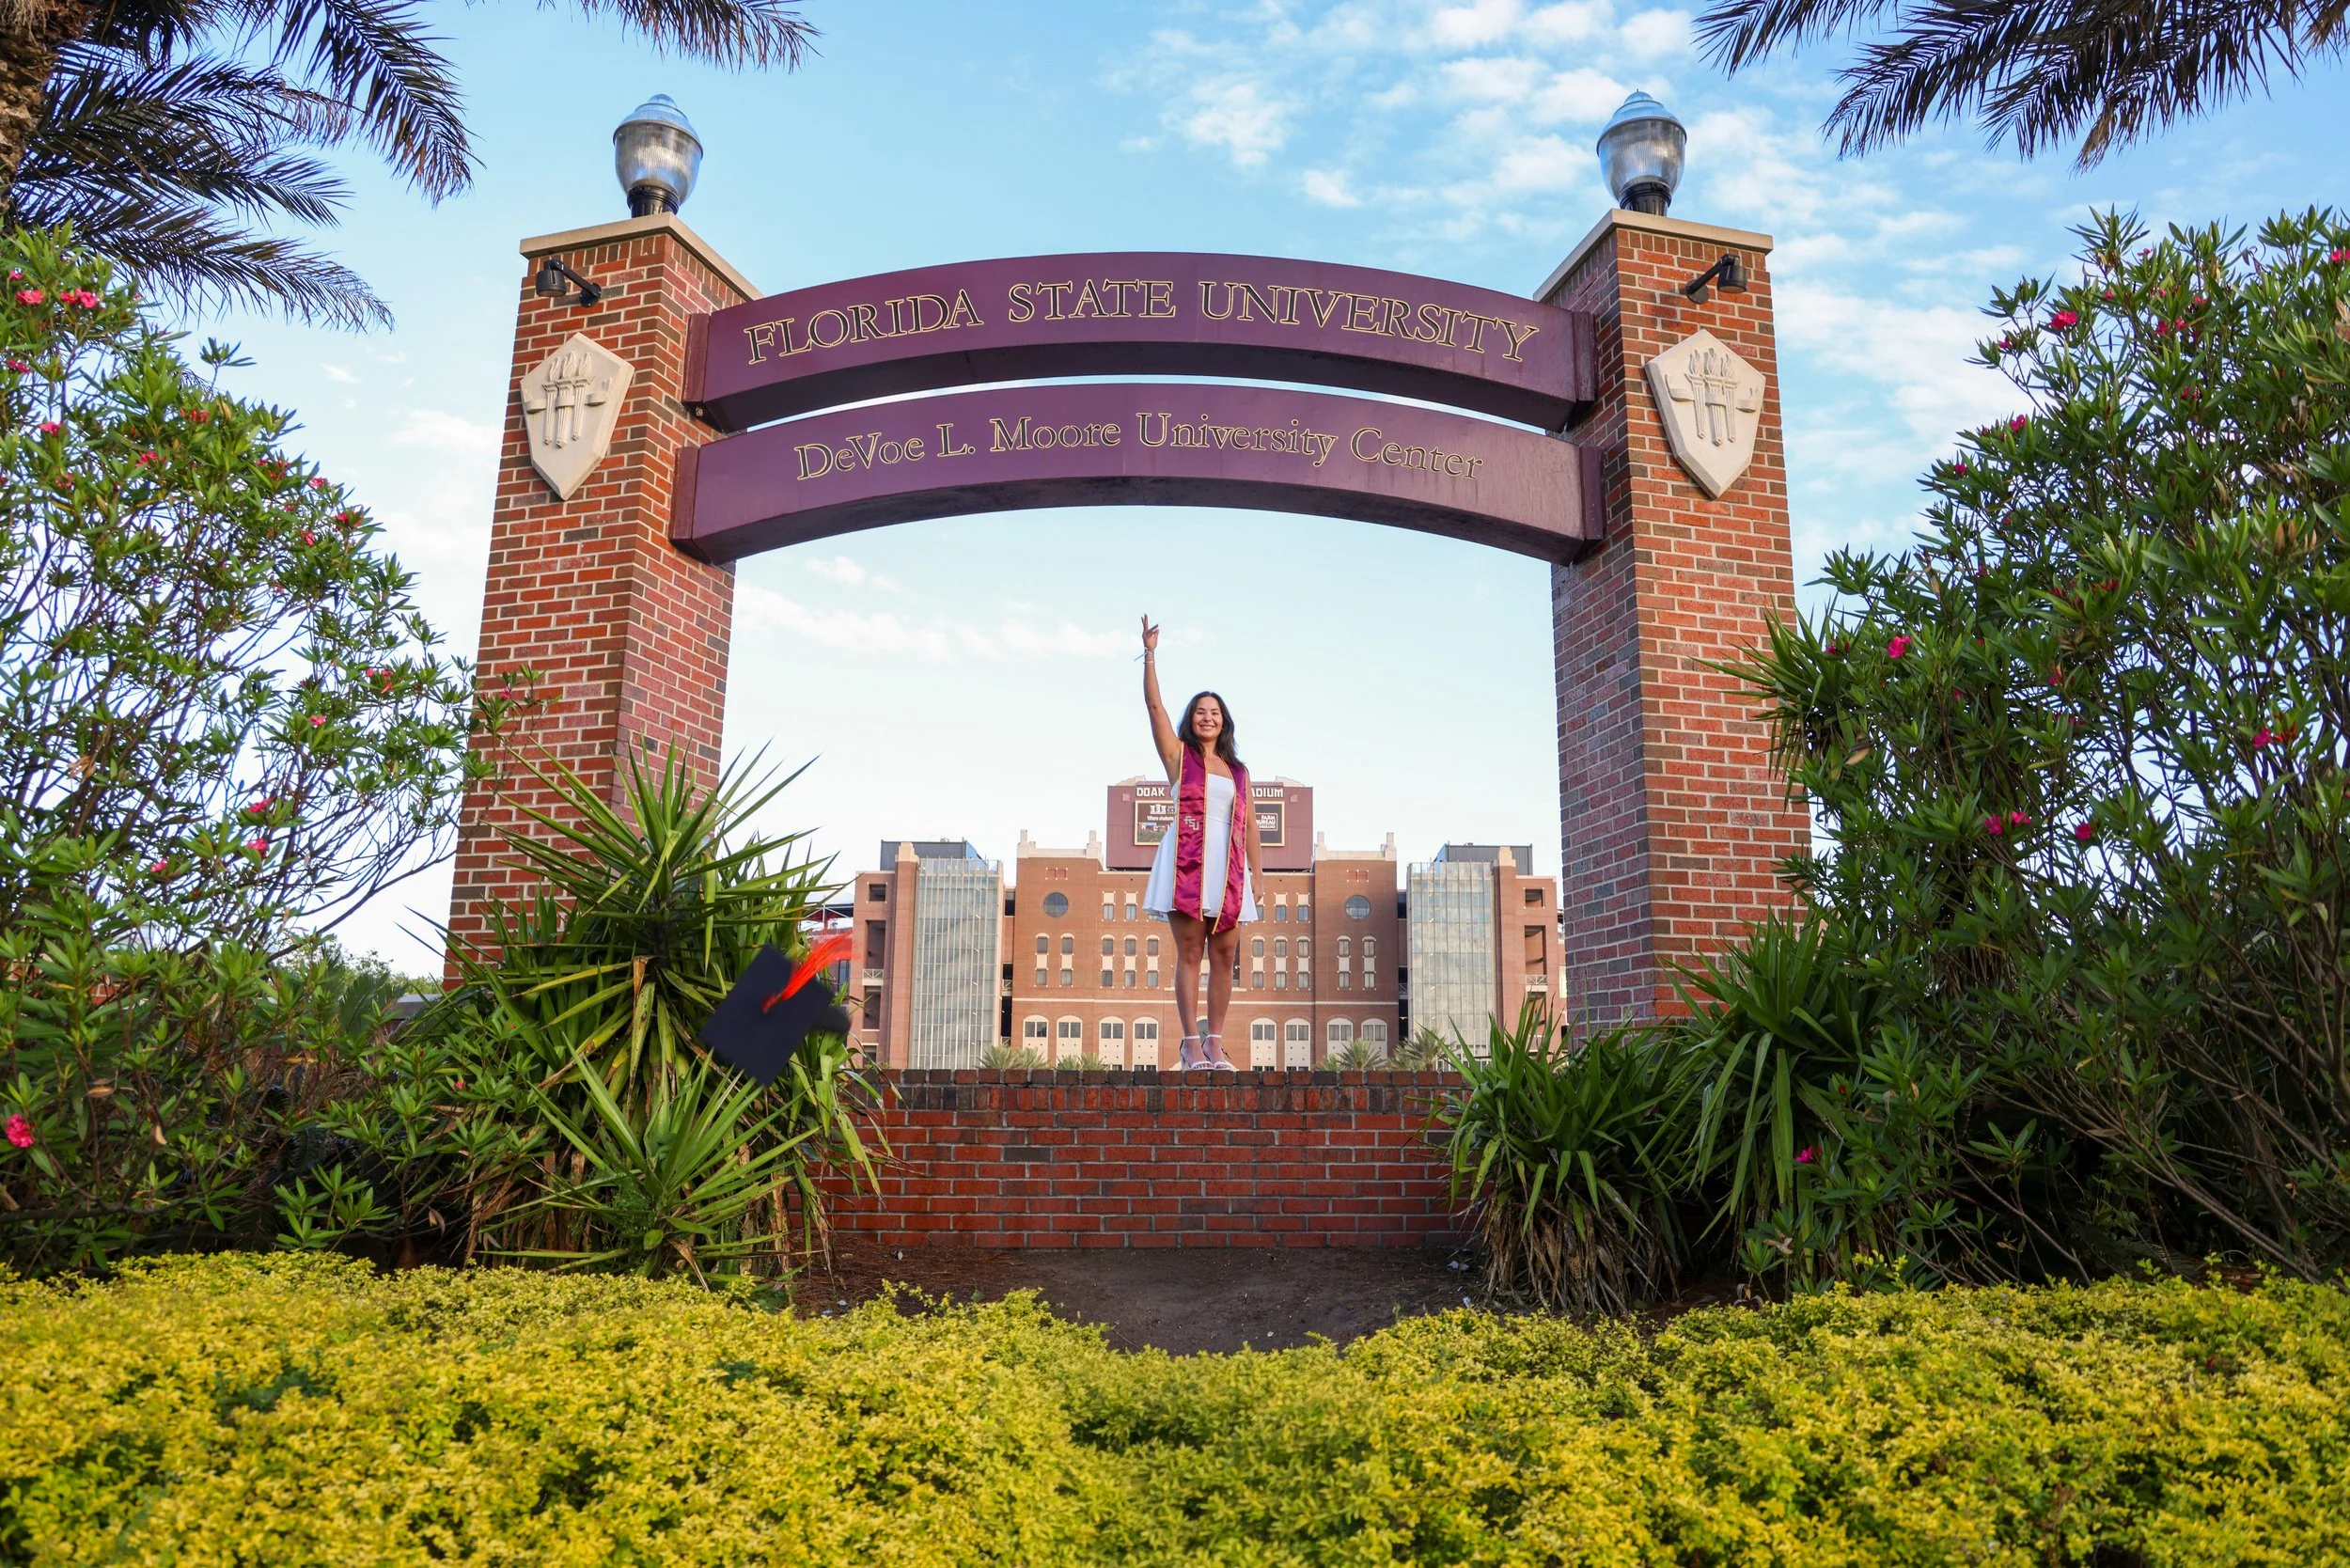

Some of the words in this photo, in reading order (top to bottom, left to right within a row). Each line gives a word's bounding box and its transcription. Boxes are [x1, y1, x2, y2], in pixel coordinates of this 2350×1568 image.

[744, 289, 984, 365] FLORIDA
[1008, 278, 1177, 322] STATE
[1198, 282, 1540, 362] UNIVERSITY
[794, 431, 925, 481] DeVoe
[936, 423, 976, 458] L.
[990, 416, 1121, 452] Moore
[1136, 412, 1339, 468] University
[1350, 427, 1484, 480] Center
[1136, 787, 1166, 797] DOAK
[1183, 815, 1200, 831] FSU
